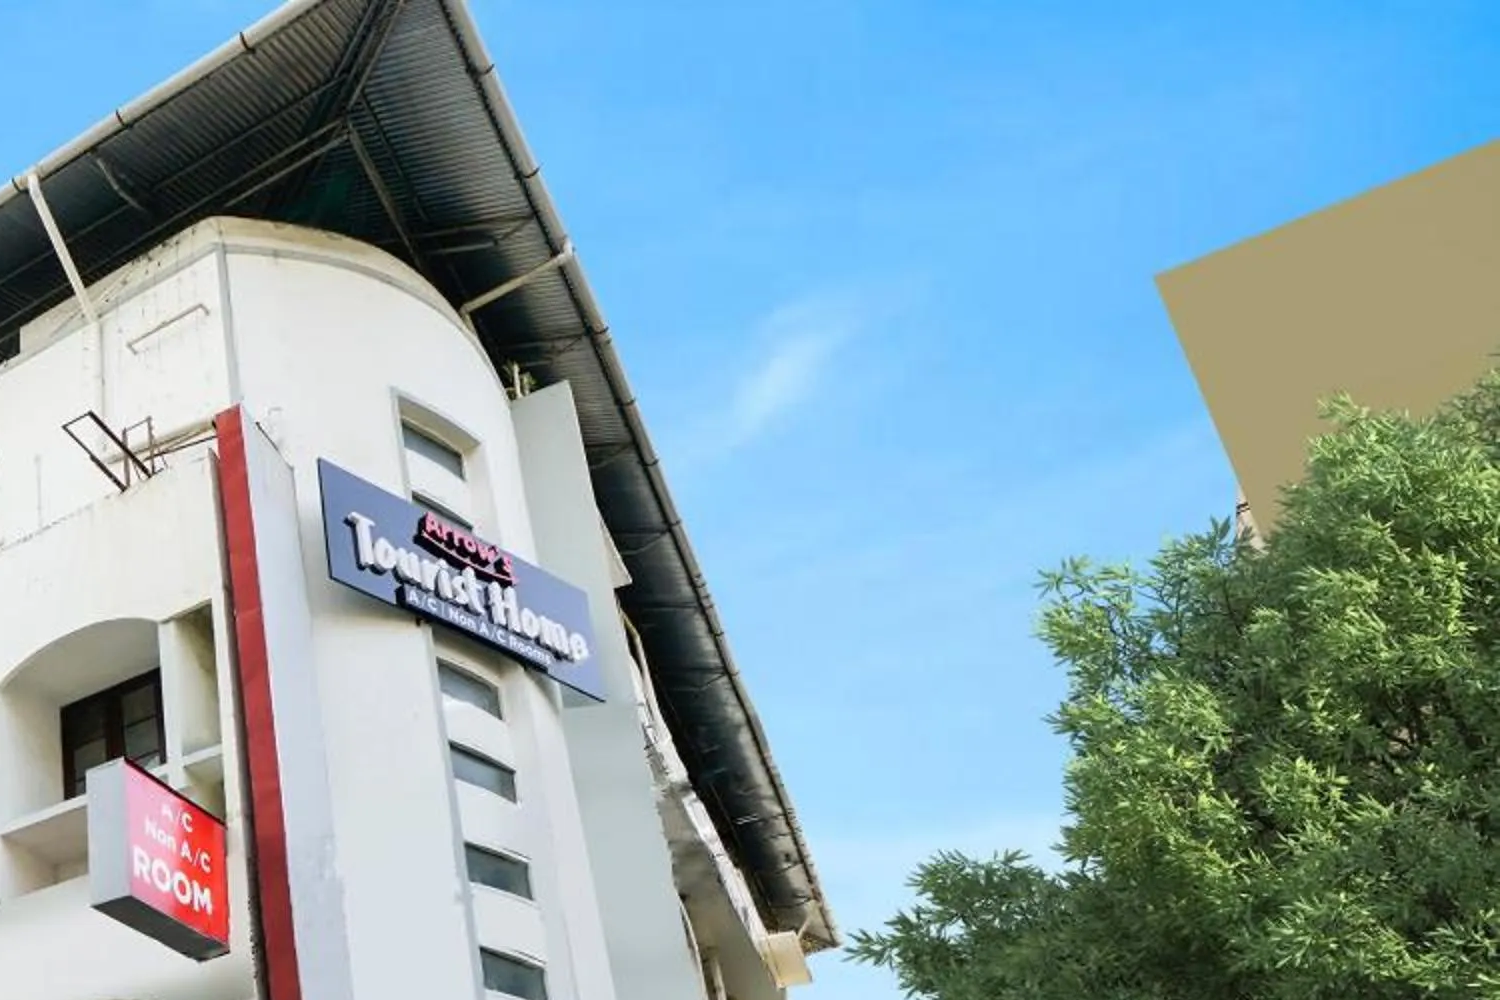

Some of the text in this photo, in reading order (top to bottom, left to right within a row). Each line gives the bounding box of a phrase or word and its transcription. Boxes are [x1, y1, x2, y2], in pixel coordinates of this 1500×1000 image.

[424, 511, 513, 573] Arrow's
[347, 512, 590, 661] Tourist Home
[408, 591, 550, 665] A/C Non A/C Rooms
[145, 818, 211, 873] Non A/C
[161, 803, 193, 833] A/C
[133, 846, 213, 915] ROOM
